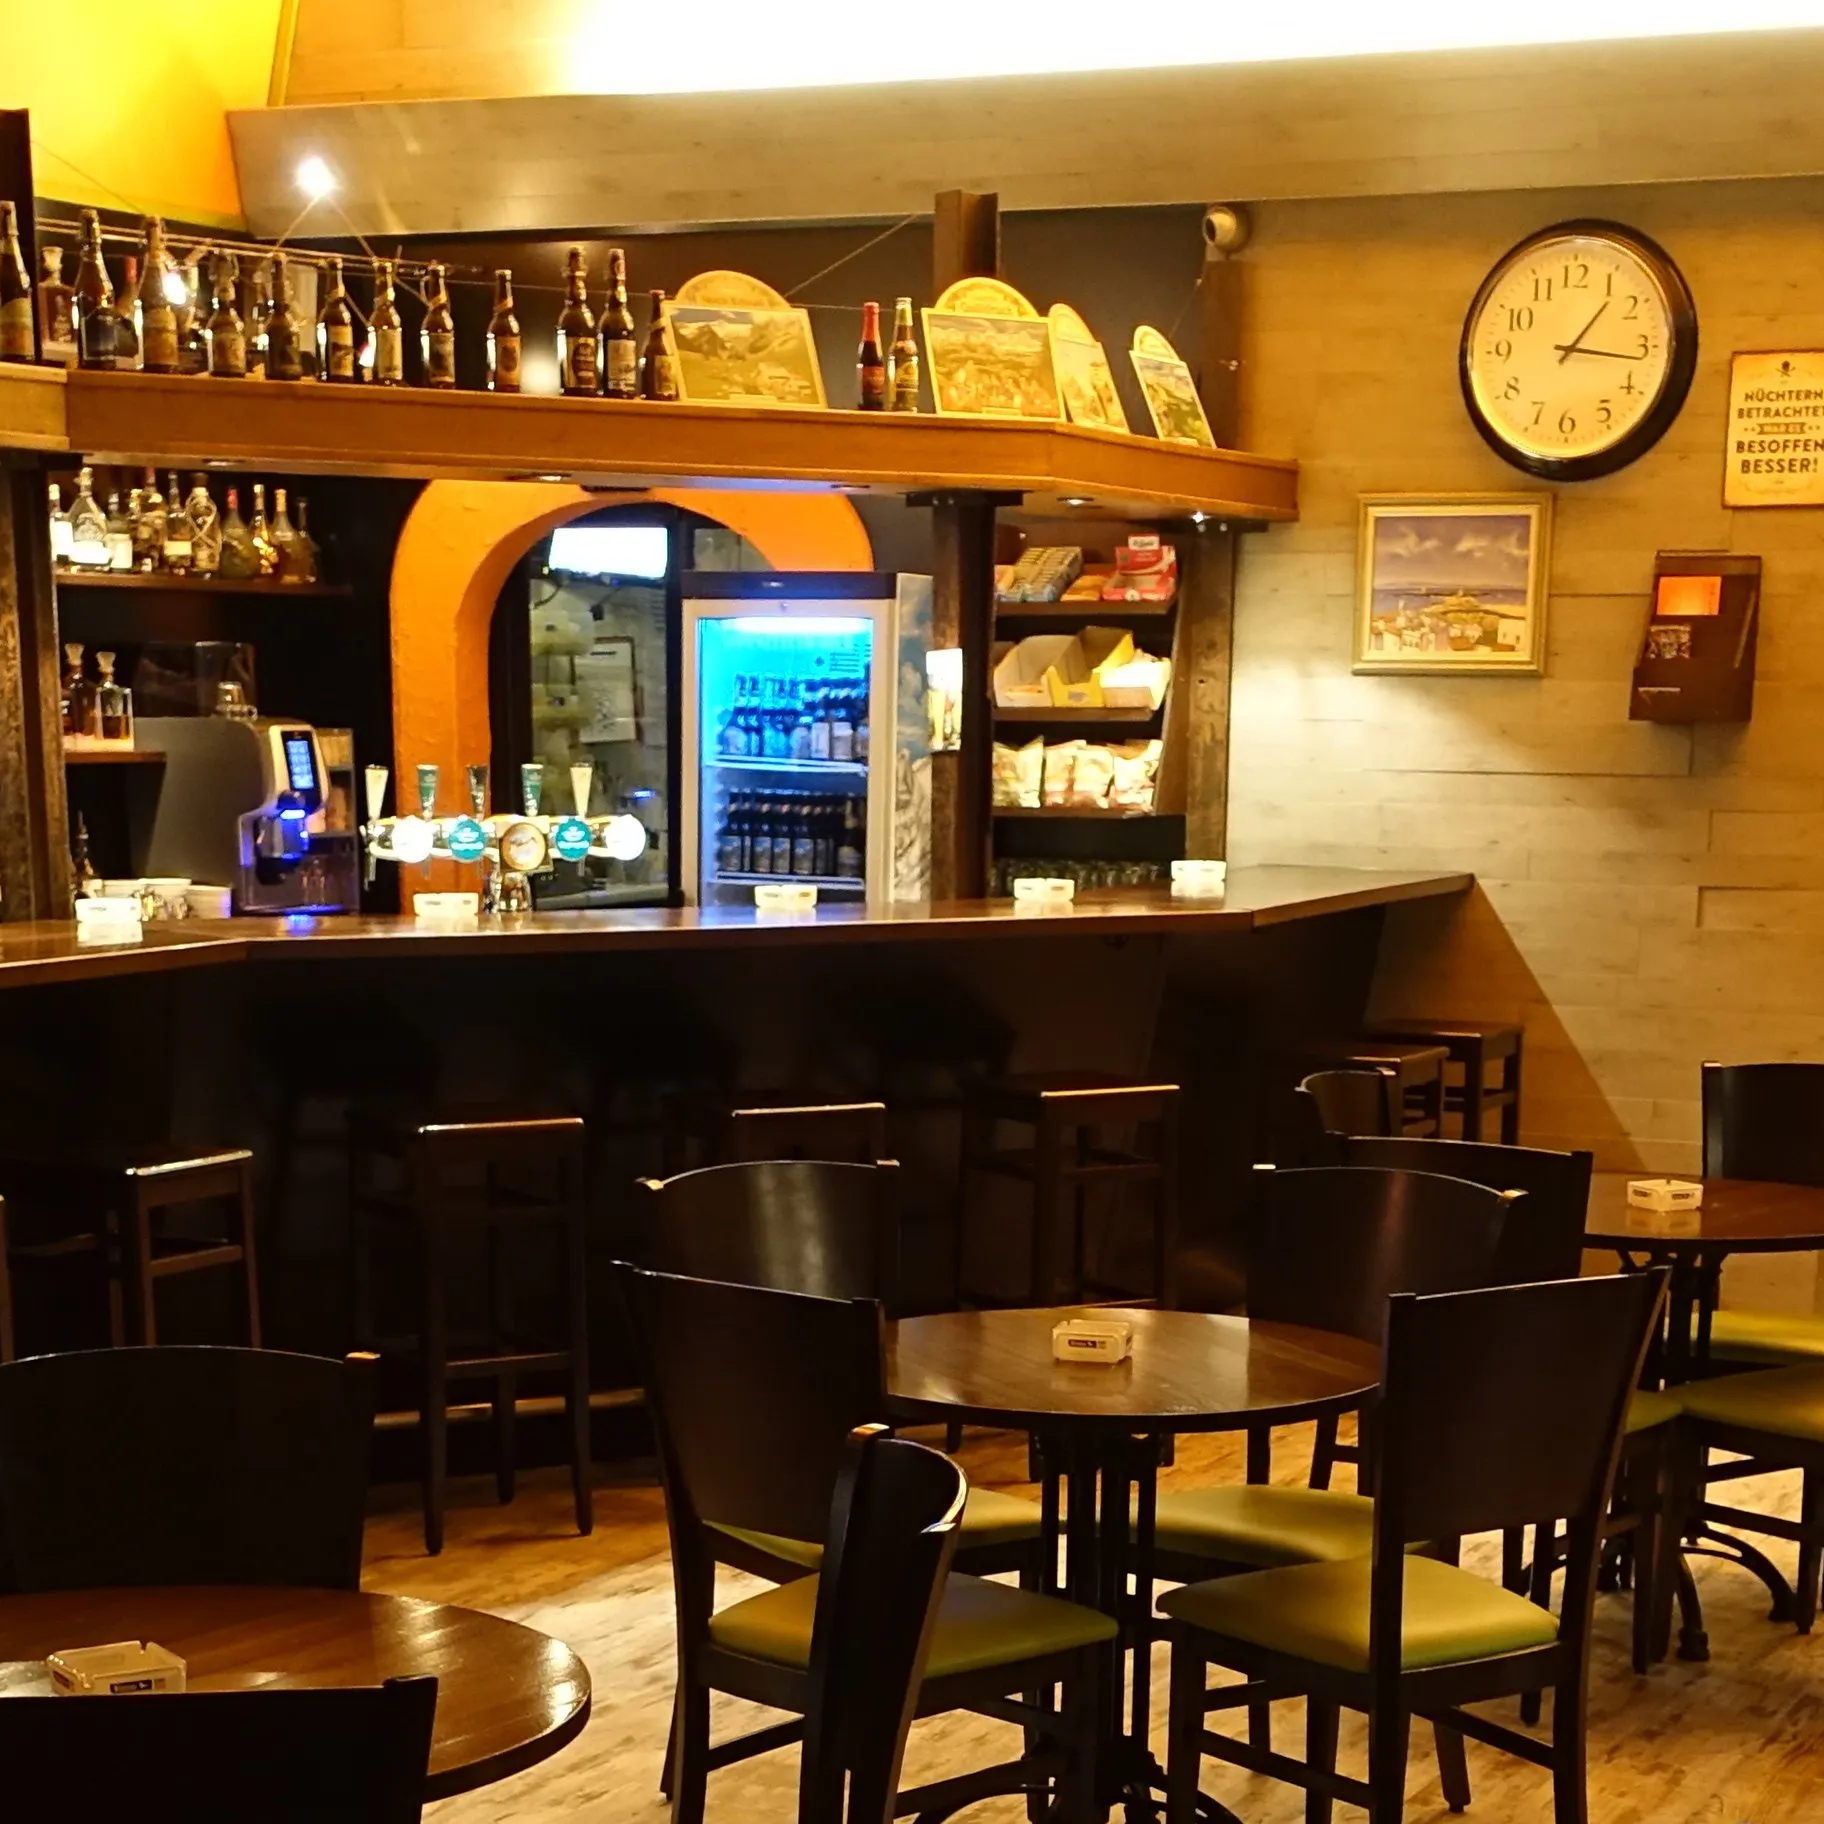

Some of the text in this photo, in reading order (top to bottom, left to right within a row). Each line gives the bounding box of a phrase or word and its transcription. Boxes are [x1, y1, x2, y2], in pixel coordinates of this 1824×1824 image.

[1561, 263, 1589, 289] 12
[1605, 273, 1613, 297] 1
[1532, 278, 1553, 302] 11
[1507, 307, 1534, 332] 10
[1622, 295, 1638, 320] 2
[1495, 339, 1512, 364] 9
[1637, 334, 1649, 360] 3
[1503, 376, 1520, 401] 8
[1618, 370, 1635, 395] 4
[1744, 387, 1824, 402] NÜCHTERN
[1531, 401, 1546, 425] 7
[1558, 409, 1576, 435] 6
[1596, 399, 1611, 424] 5
[1741, 457, 1819, 474] BESSER!
